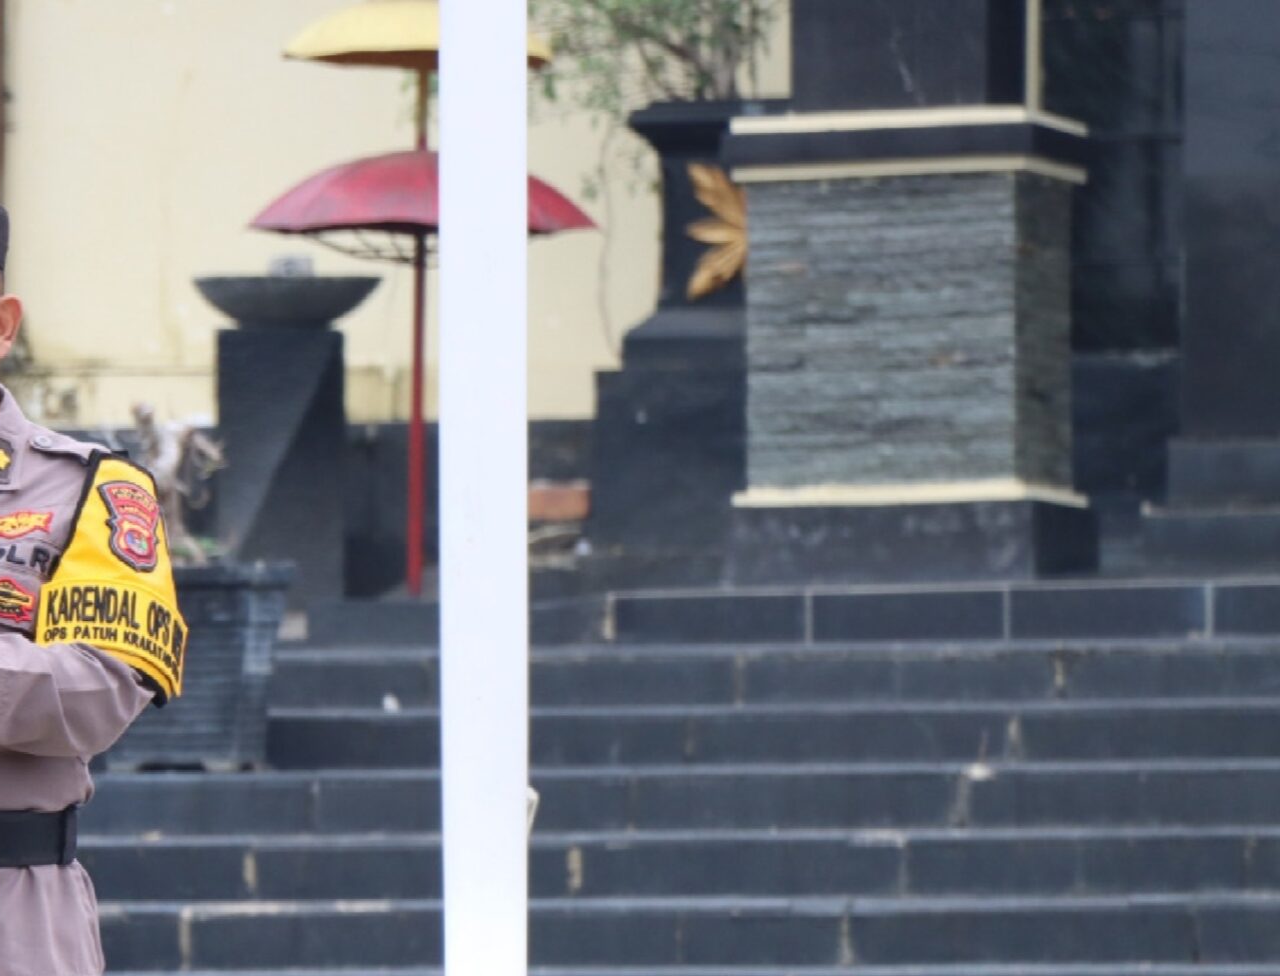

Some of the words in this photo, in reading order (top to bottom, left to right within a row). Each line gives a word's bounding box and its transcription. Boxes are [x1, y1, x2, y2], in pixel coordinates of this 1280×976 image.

[44, 625, 67, 642] OPS
[73, 624, 118, 642] PATUH
[46, 584, 140, 630] KARENDAL
[147, 601, 171, 647] OPS
